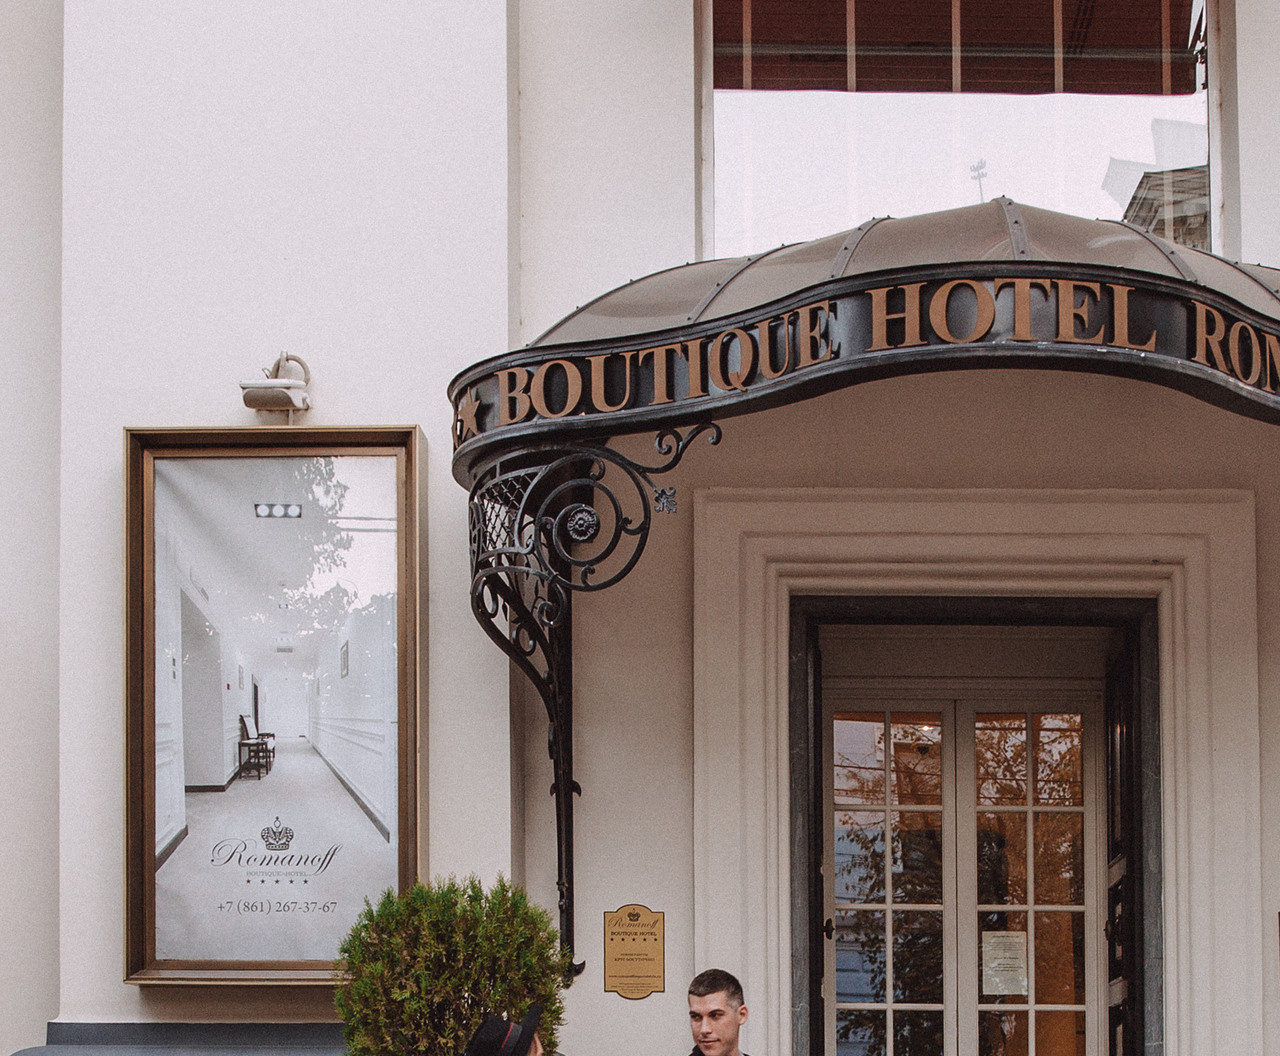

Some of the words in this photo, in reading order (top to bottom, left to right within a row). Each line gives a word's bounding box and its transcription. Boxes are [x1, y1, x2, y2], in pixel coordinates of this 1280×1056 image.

[495, 300, 840, 426] BOUTIQUE
[865, 277, 1157, 351] HOTEL
[211, 838, 343, 876] Romanoff
[217, 901, 234, 913] +7
[237, 899, 271, 915] (861)
[275, 900, 338, 913] 267-37-67
